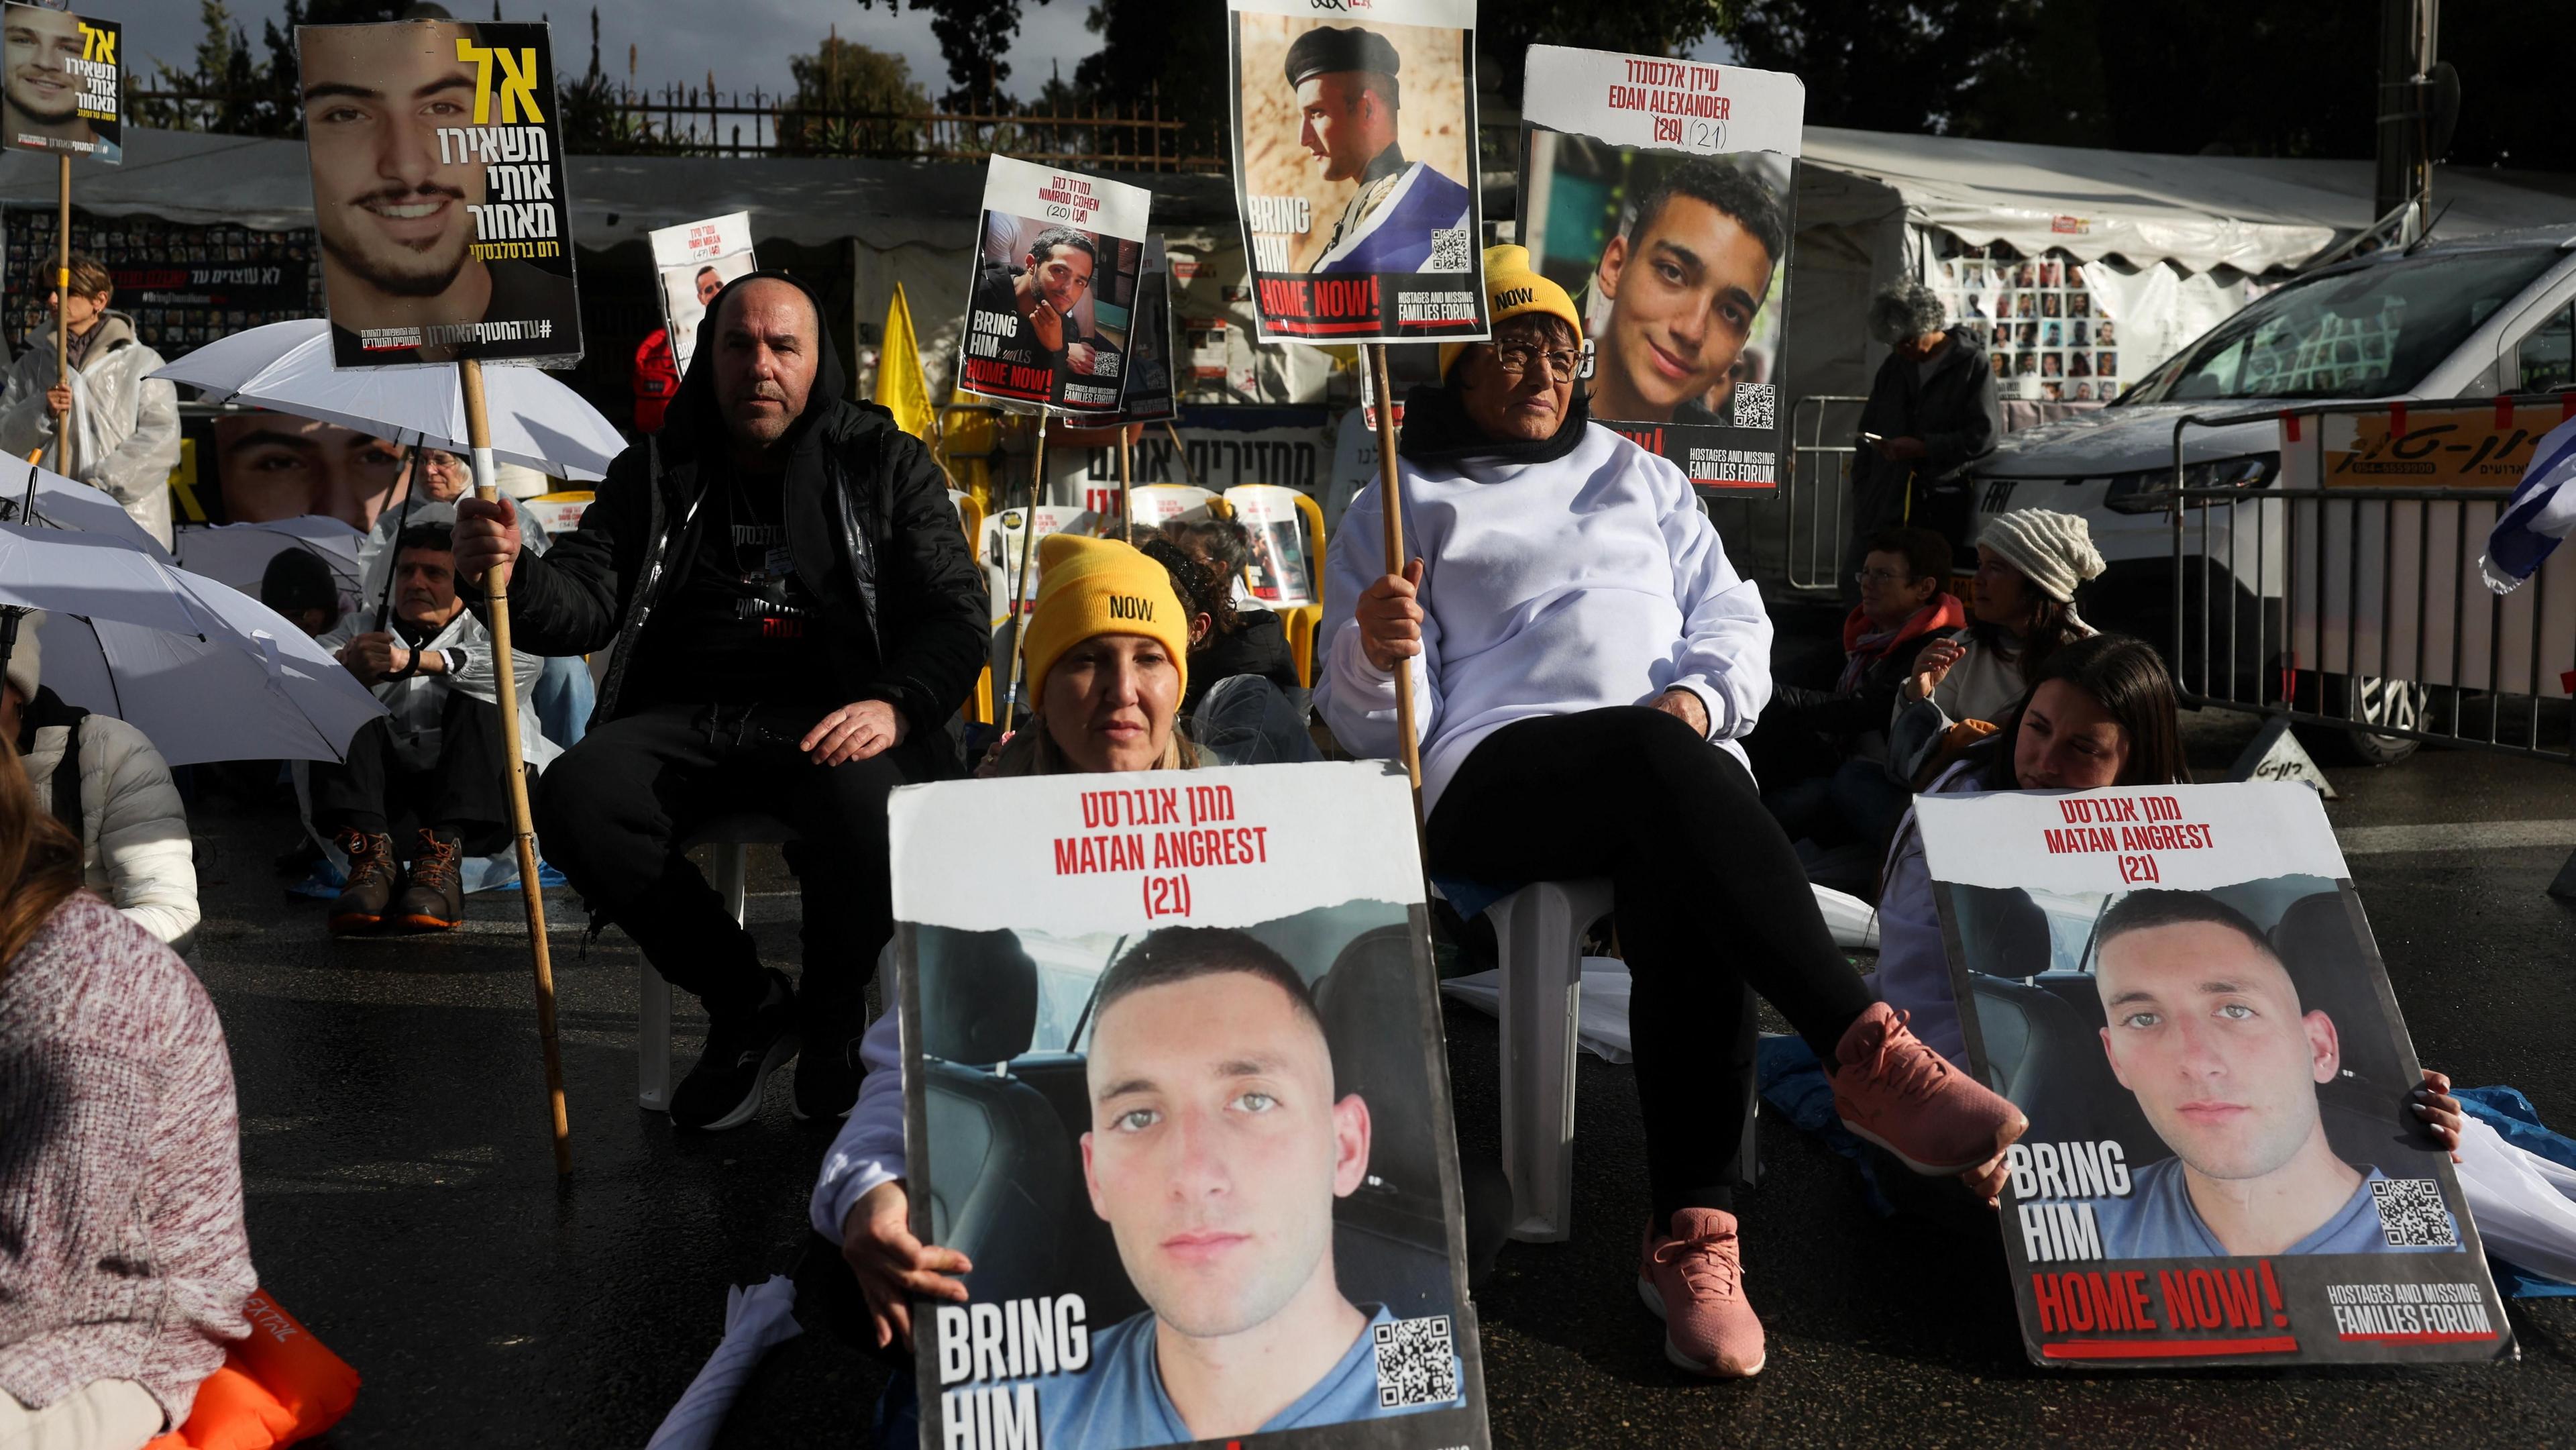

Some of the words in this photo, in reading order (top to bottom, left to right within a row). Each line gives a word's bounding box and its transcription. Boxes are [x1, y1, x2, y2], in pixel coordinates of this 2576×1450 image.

[78, 22, 116, 64] אל
[65, 58, 116, 80] תשאירו
[455, 38, 545, 123] אל
[1625, 59, 1685, 88] אלכסנדר
[1690, 66, 1719, 92] עידן
[87, 77, 116, 97] אותי
[75, 92, 116, 113] מאחור
[1609, 85, 1646, 111] EDAN
[1649, 89, 1730, 120] ALEXANDER
[437, 127, 549, 164] תשאירו
[1689, 119, 1726, 149] (21)
[488, 164, 553, 200] אותי
[1052, 176, 1066, 190] כהן
[1069, 179, 1091, 195] נמרוד
[1039, 187, 1071, 205] NIMROD
[1073, 195, 1099, 211] COHEN
[1046, 204, 1070, 219] (20)
[467, 203, 557, 240] מאחור
[1247, 197, 1310, 234] BRING
[470, 242, 534, 262] ברסלבסקי
[538, 241, 559, 257] רום
[704, 235, 720, 247] MIRAN
[1253, 236, 1289, 273] HIM
[1259, 278, 1309, 318] HOME
[1314, 275, 1380, 316] NOW!
[1398, 292, 1430, 304] HOSTAGES
[1430, 292, 1444, 303] AND
[1445, 291, 1474, 303] MISSING
[973, 309, 1018, 338] BRING
[1398, 304, 1440, 321] FAMILIES
[1442, 303, 1475, 321] FORUM
[362, 338, 392, 350] והנעדרים
[393, 335, 422, 348] החטופים
[969, 333, 999, 358] HIM
[966, 358, 1008, 384] HOME
[1010, 366, 1053, 393] NOW!
[1065, 383, 1087, 391] HOSTAGES
[1088, 386, 1097, 394] AND
[1064, 390, 1093, 403] FAMILIES
[1093, 394, 1116, 404] FORUM
[1187, 439, 1316, 485] מחזירים
[1690, 448, 1727, 463] HOSTAGES
[1728, 451, 1743, 463] AND
[1743, 451, 1775, 465] MISSING
[1689, 460, 1735, 480] FAMILIES
[1737, 463, 1774, 484] FORUM
[1110, 595, 1157, 623] NOW.
[1081, 788, 1180, 828] אנגרסט
[1186, 785, 1235, 827] מתן
[2059, 798, 2139, 824] אנגרסט
[2139, 796, 2182, 824] מתן
[1054, 834, 1145, 875] MATAN
[1154, 827, 1267, 869] ANGREST
[2043, 827, 2118, 854] MATAN
[2121, 824, 2213, 851] ANGREST
[2118, 854, 2159, 884] (21)
[1143, 874, 1191, 920] (21)
[2006, 1140, 2131, 1199] BRING
[2018, 1202, 2102, 1262] HIM
[2032, 1271, 2157, 1333] HOME
[2159, 1259, 2289, 1331] NOW!
[2326, 1284, 2394, 1304] HOSTAGES
[2394, 1284, 2422, 1304] AND
[2421, 1283, 2481, 1304] MISSING
[2332, 1304, 2421, 1335] FAMILIES
[2420, 1304, 2492, 1333] FORUM
[936, 1293, 1089, 1385] BRING
[941, 1382, 1039, 1450] HIM
